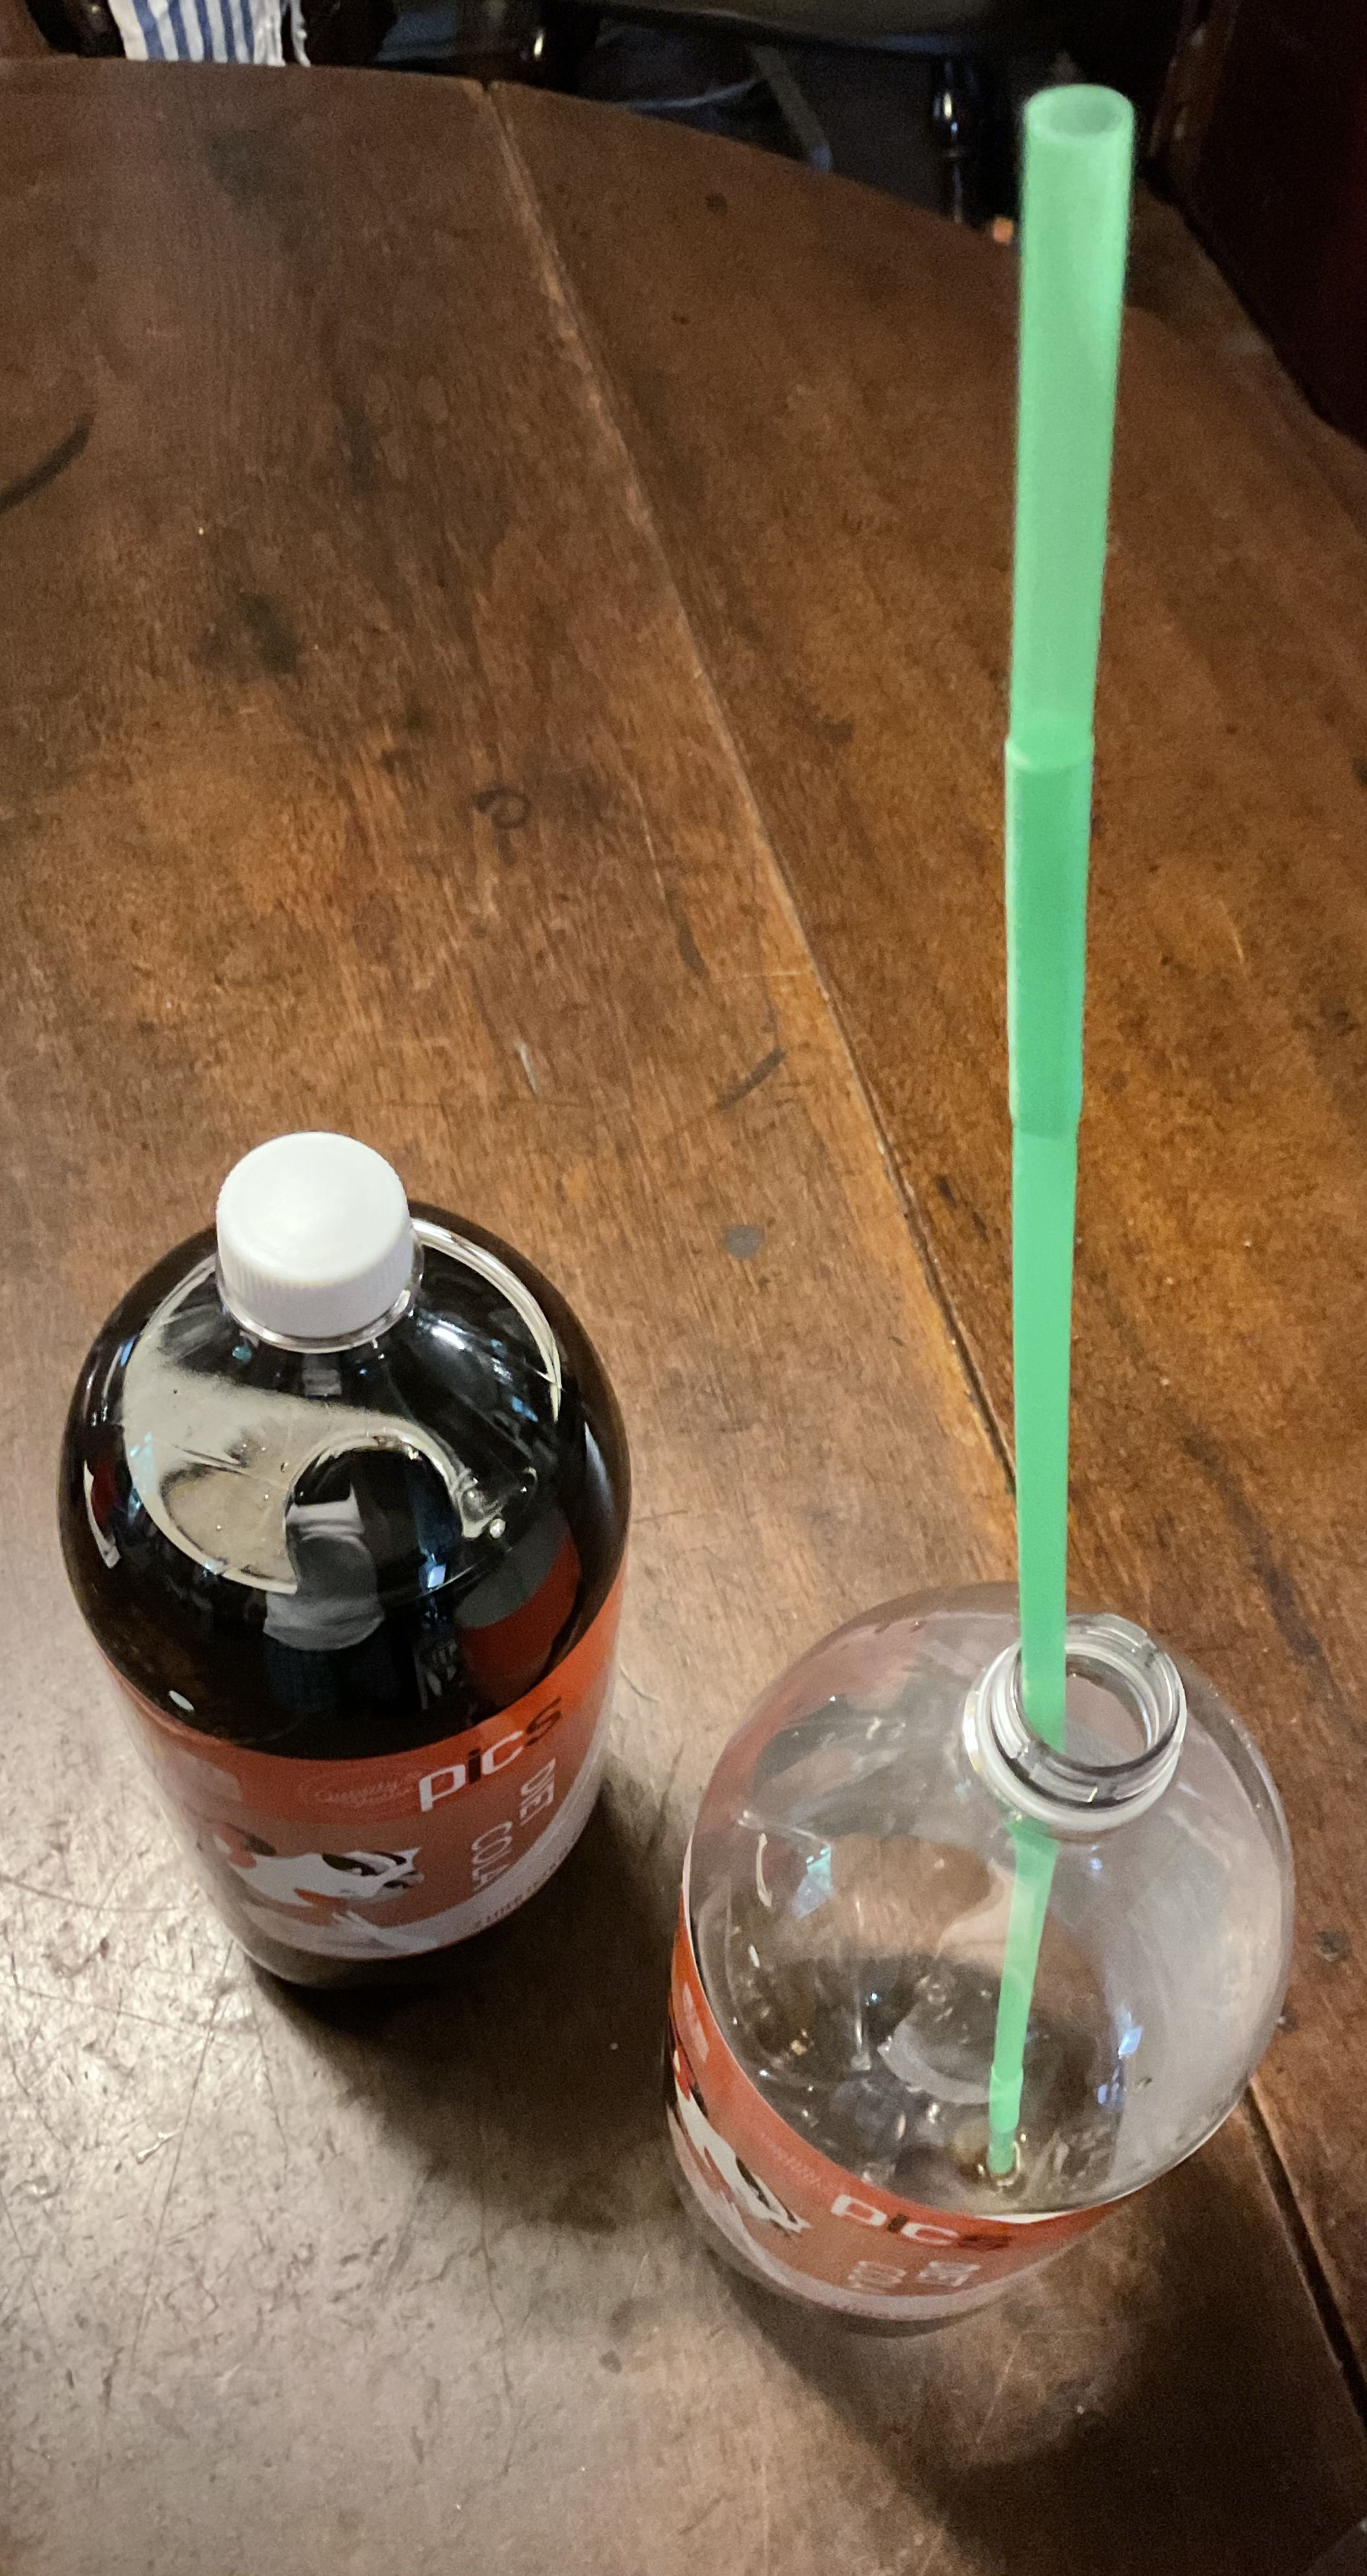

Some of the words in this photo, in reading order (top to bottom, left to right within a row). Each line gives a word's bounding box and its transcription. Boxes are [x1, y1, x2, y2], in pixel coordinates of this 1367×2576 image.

[418, 1696, 562, 1812] pics
[520, 1758, 556, 1826] DIET
[472, 1821, 513, 1893] COLA
